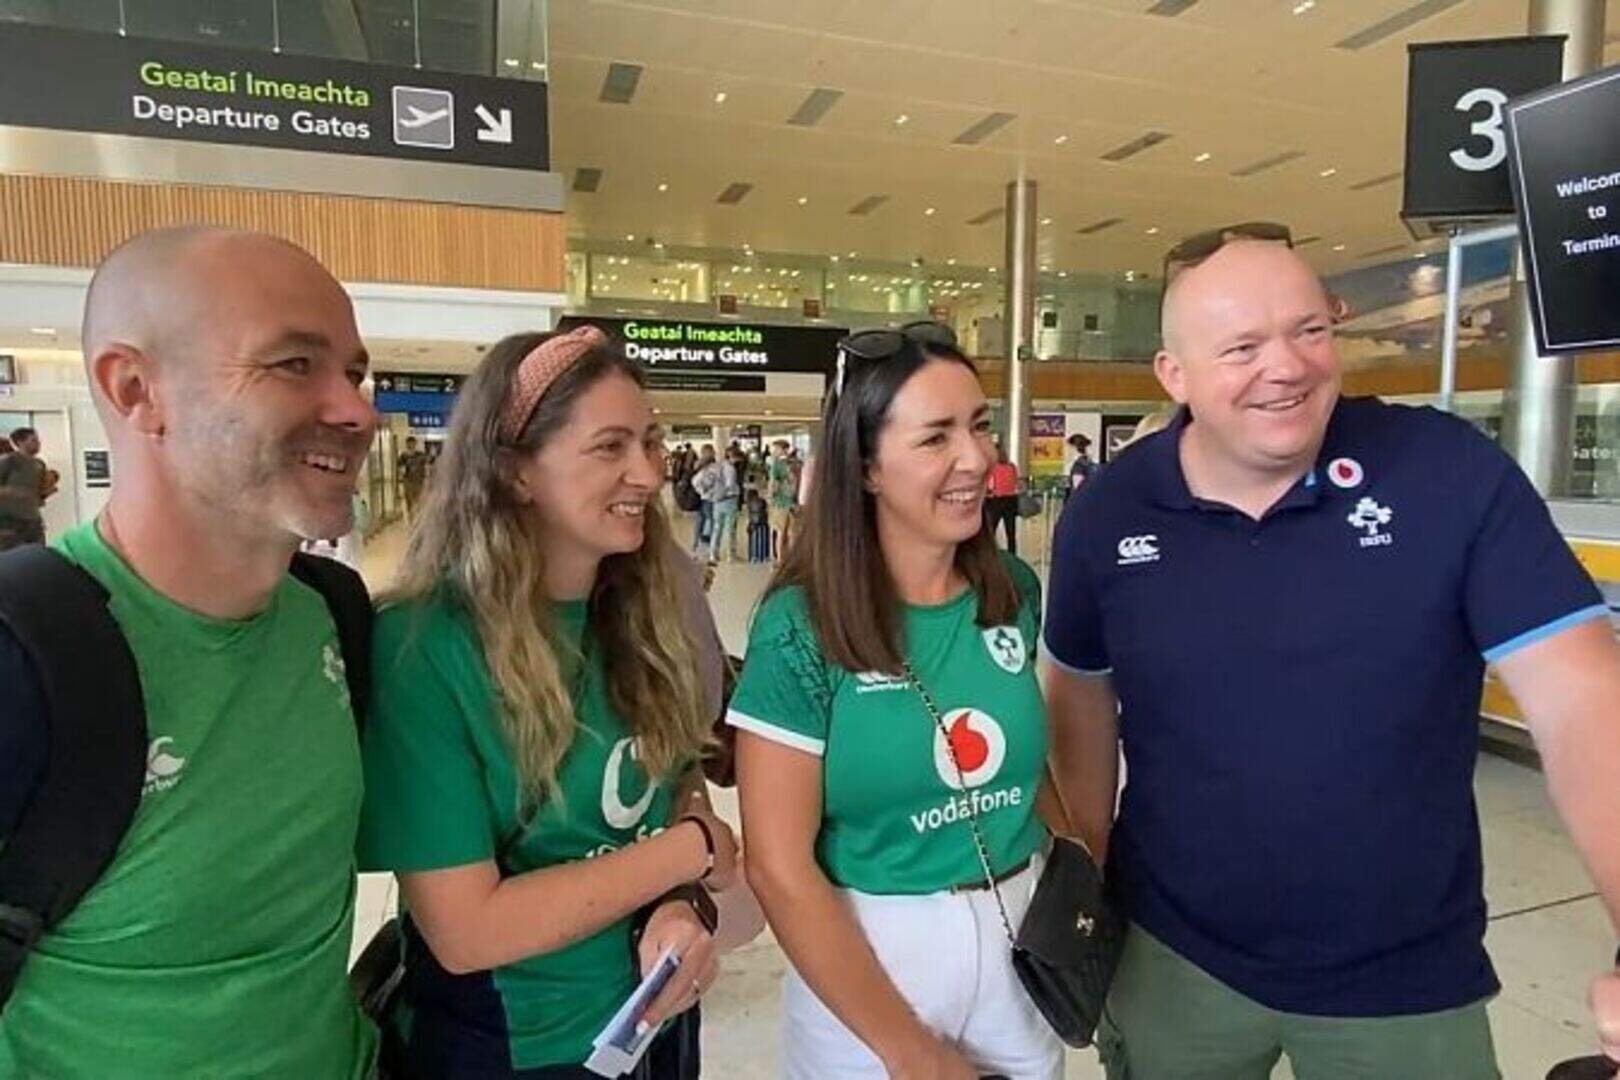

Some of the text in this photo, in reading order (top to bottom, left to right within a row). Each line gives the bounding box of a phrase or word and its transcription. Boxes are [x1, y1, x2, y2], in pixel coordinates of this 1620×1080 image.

[141, 61, 369, 107] Geataí Imeachta
[132, 94, 371, 139] Departure Gates
[1449, 87, 1509, 171] 3
[1587, 205, 1607, 219] to
[1562, 233, 1620, 255] Termin
[686, 325, 763, 343] Imeachta
[625, 343, 768, 364] Departure Gates
[910, 786, 1021, 833] vodafone
